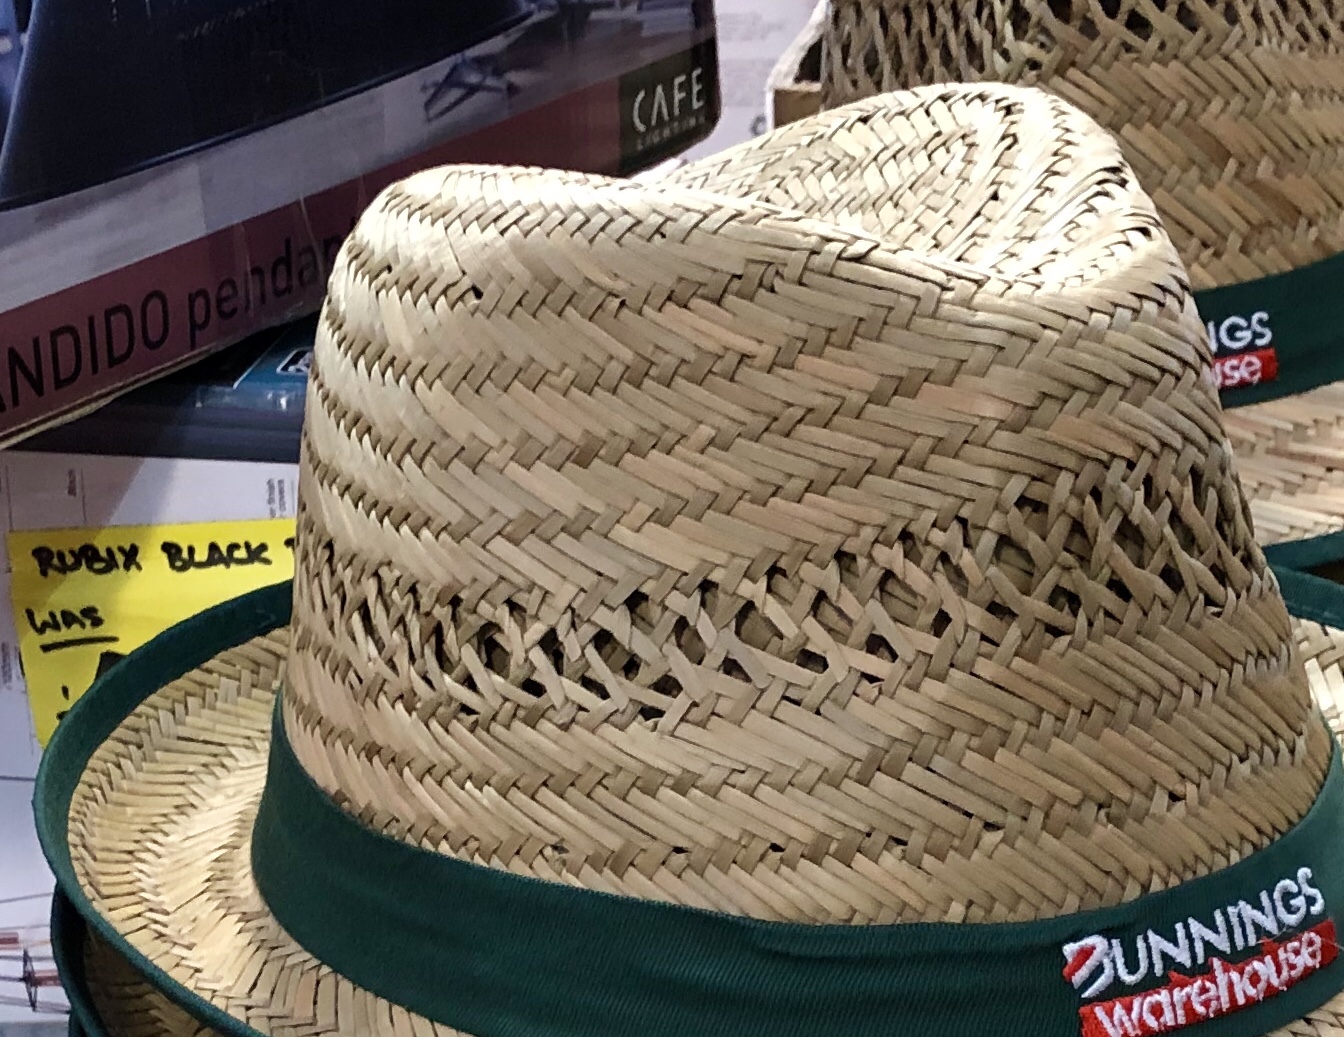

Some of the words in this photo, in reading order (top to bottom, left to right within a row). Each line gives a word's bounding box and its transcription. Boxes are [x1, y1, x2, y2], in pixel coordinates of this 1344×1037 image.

[633, 67, 704, 132] CAFE
[32, 542, 142, 577] RUBIX
[161, 541, 272, 572] BLACK
[25, 605, 104, 636] WAS
[1062, 866, 1325, 998] BUNNINGS
